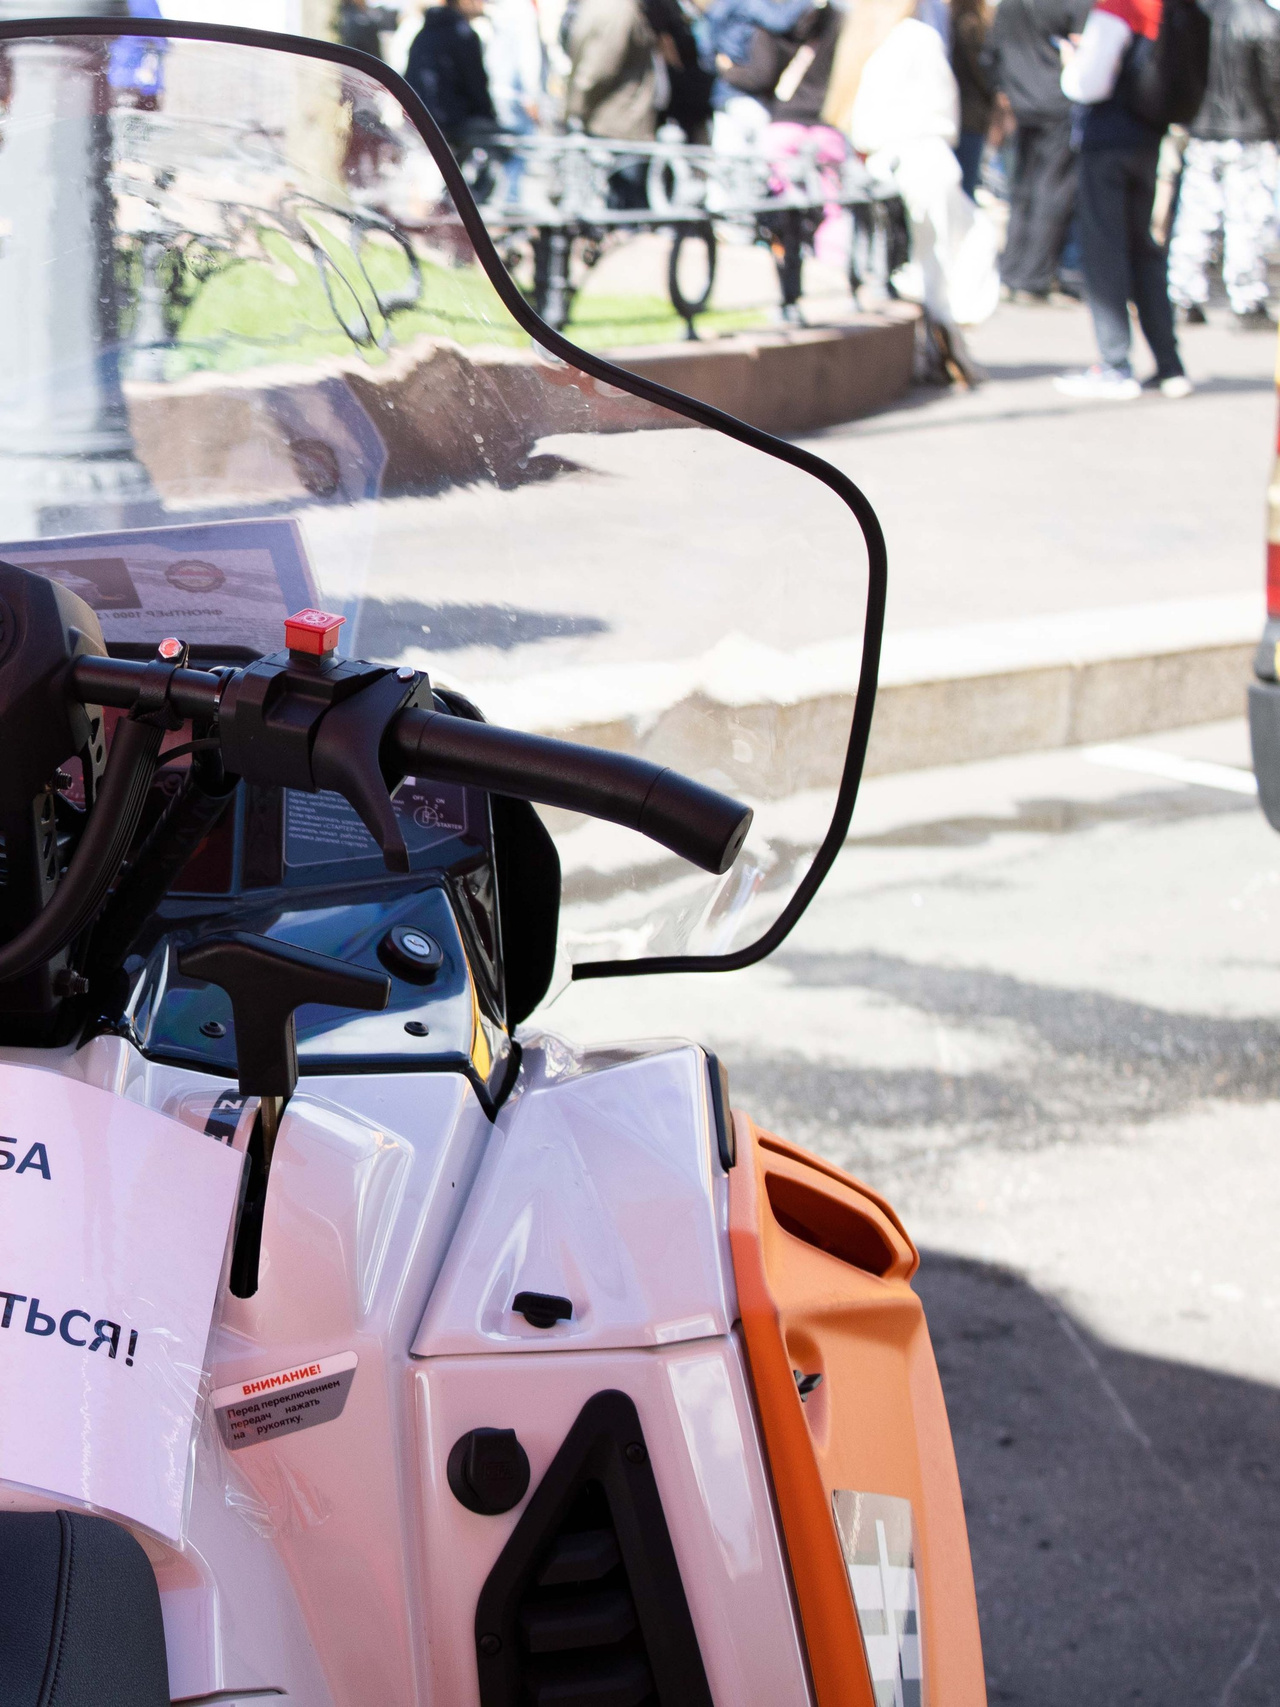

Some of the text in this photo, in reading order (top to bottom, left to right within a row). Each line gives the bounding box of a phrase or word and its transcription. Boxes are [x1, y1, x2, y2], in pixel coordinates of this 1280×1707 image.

[436, 822, 463, 830] STARTER
[242, 1364, 322, 1395] ВНИМАНИЕ!
[227, 1380, 341, 1419] Перед переключением
[230, 1398, 321, 1430] передач нажать
[233, 1413, 303, 1440] на рукоятку.
